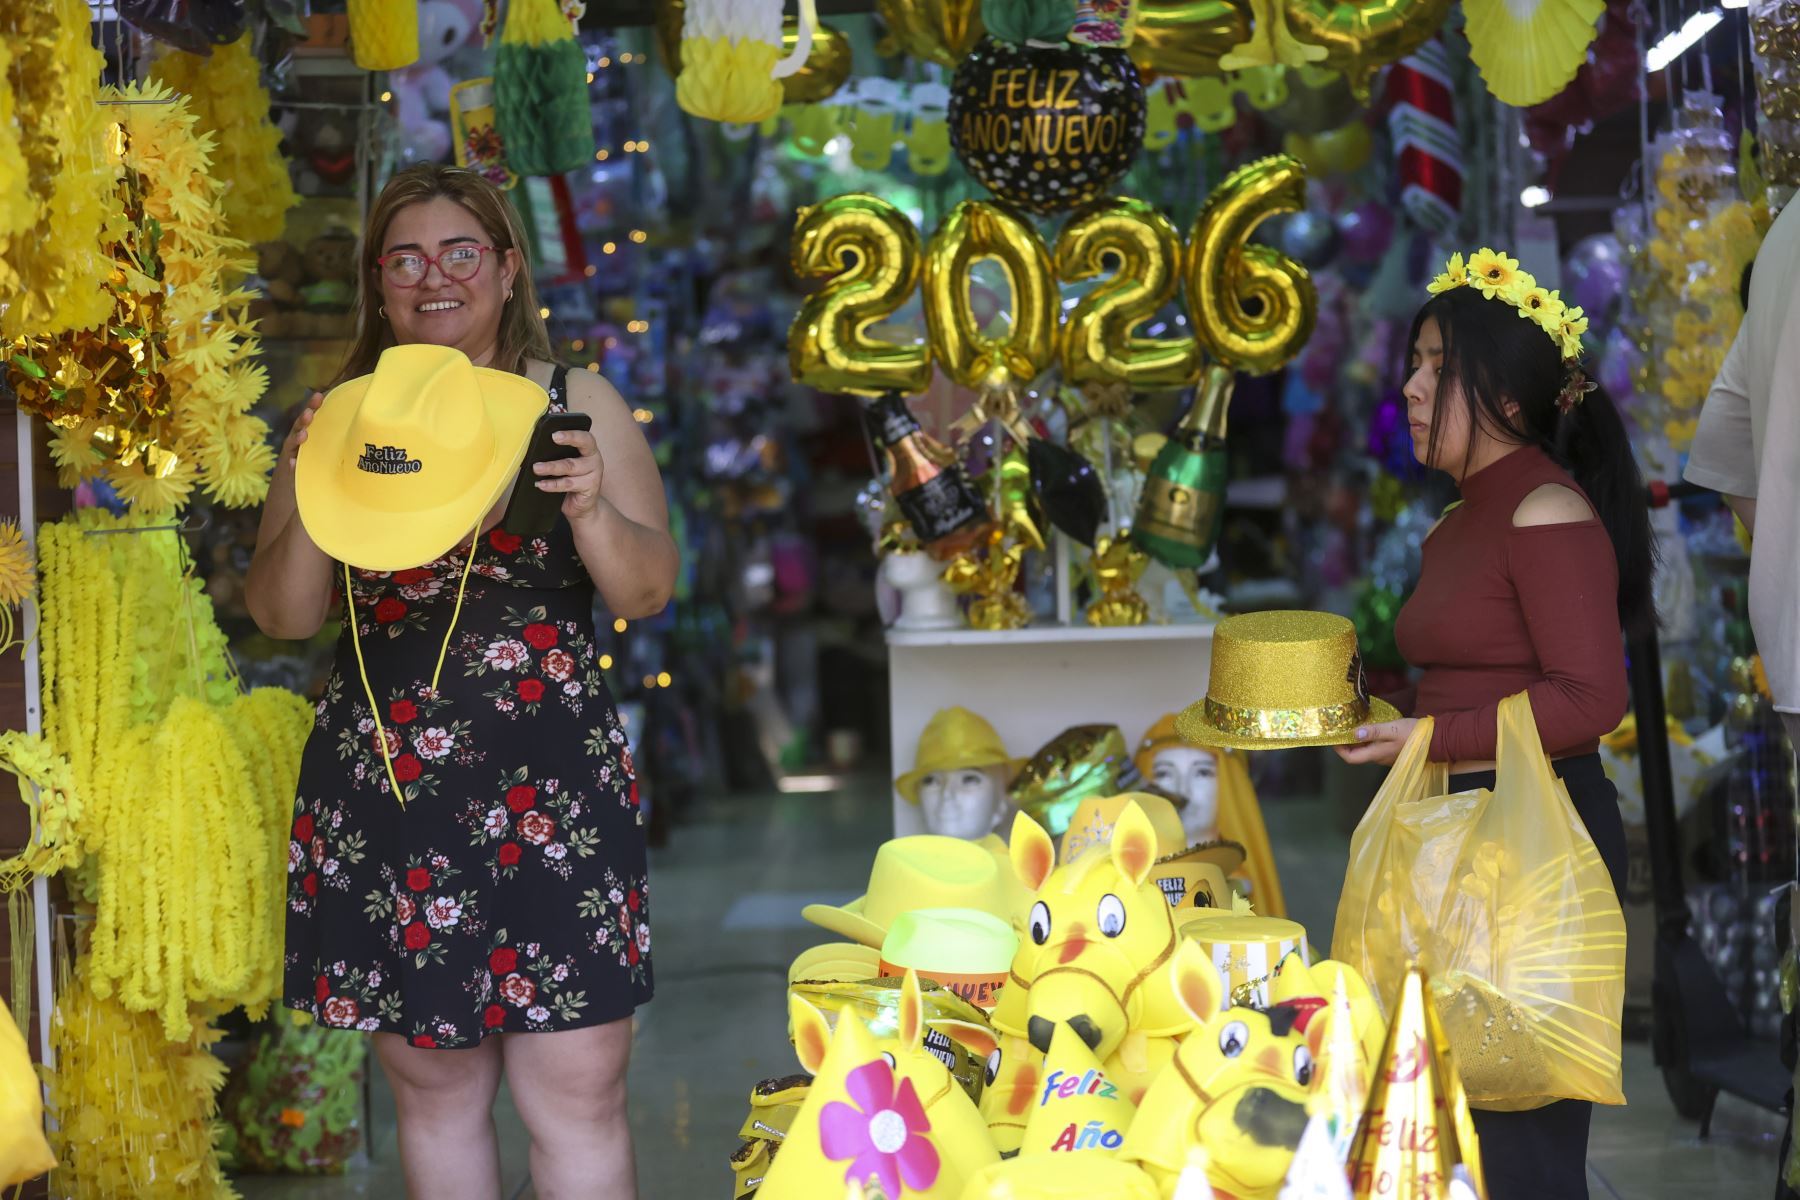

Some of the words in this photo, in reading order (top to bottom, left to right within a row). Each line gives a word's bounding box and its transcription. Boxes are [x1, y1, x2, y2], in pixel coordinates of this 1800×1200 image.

[989, 68, 1080, 110] FELIZ
[1020, 113, 1126, 155] NUEVO!
[788, 154, 1317, 395] 2026
[365, 443, 407, 461] Feliz
[1041, 1069, 1119, 1107] Feliz
[1050, 1120, 1123, 1152] Año
